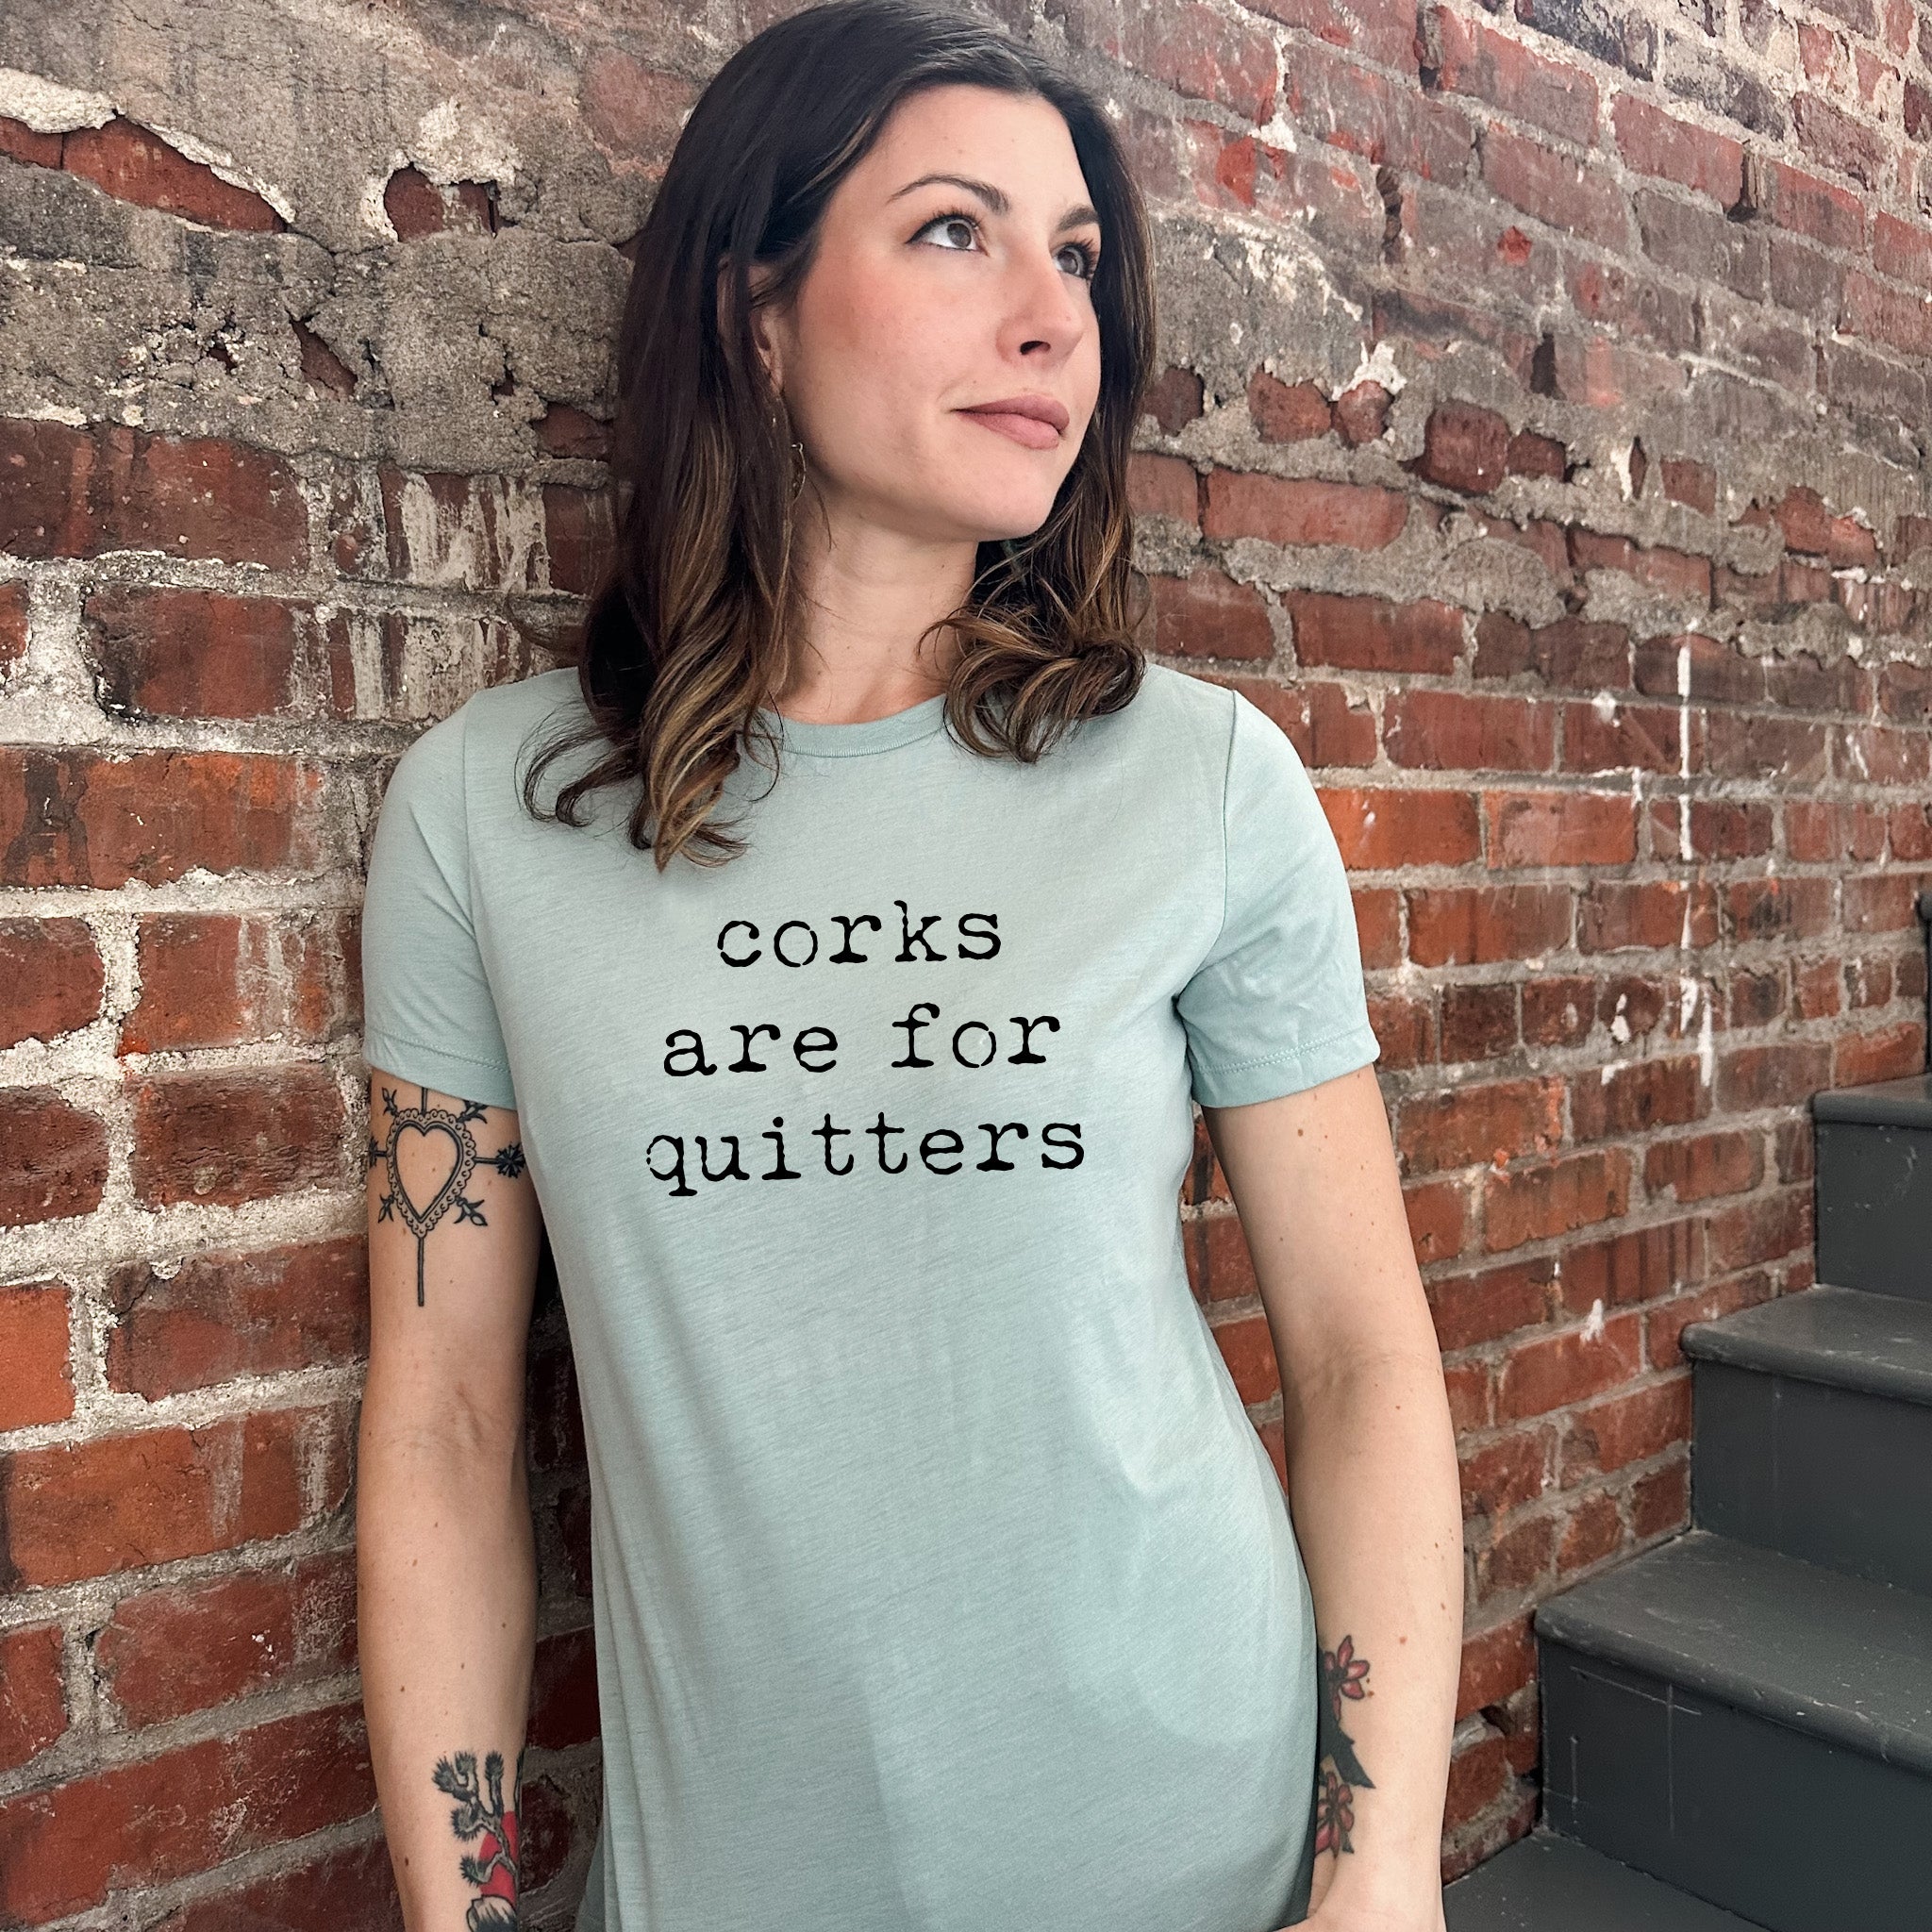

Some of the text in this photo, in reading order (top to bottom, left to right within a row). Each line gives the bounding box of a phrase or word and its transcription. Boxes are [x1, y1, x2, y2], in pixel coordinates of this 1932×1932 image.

[717, 900, 1002, 968] corks
[663, 1002, 1061, 1077] are for
[646, 1111, 1086, 1197] quitters
